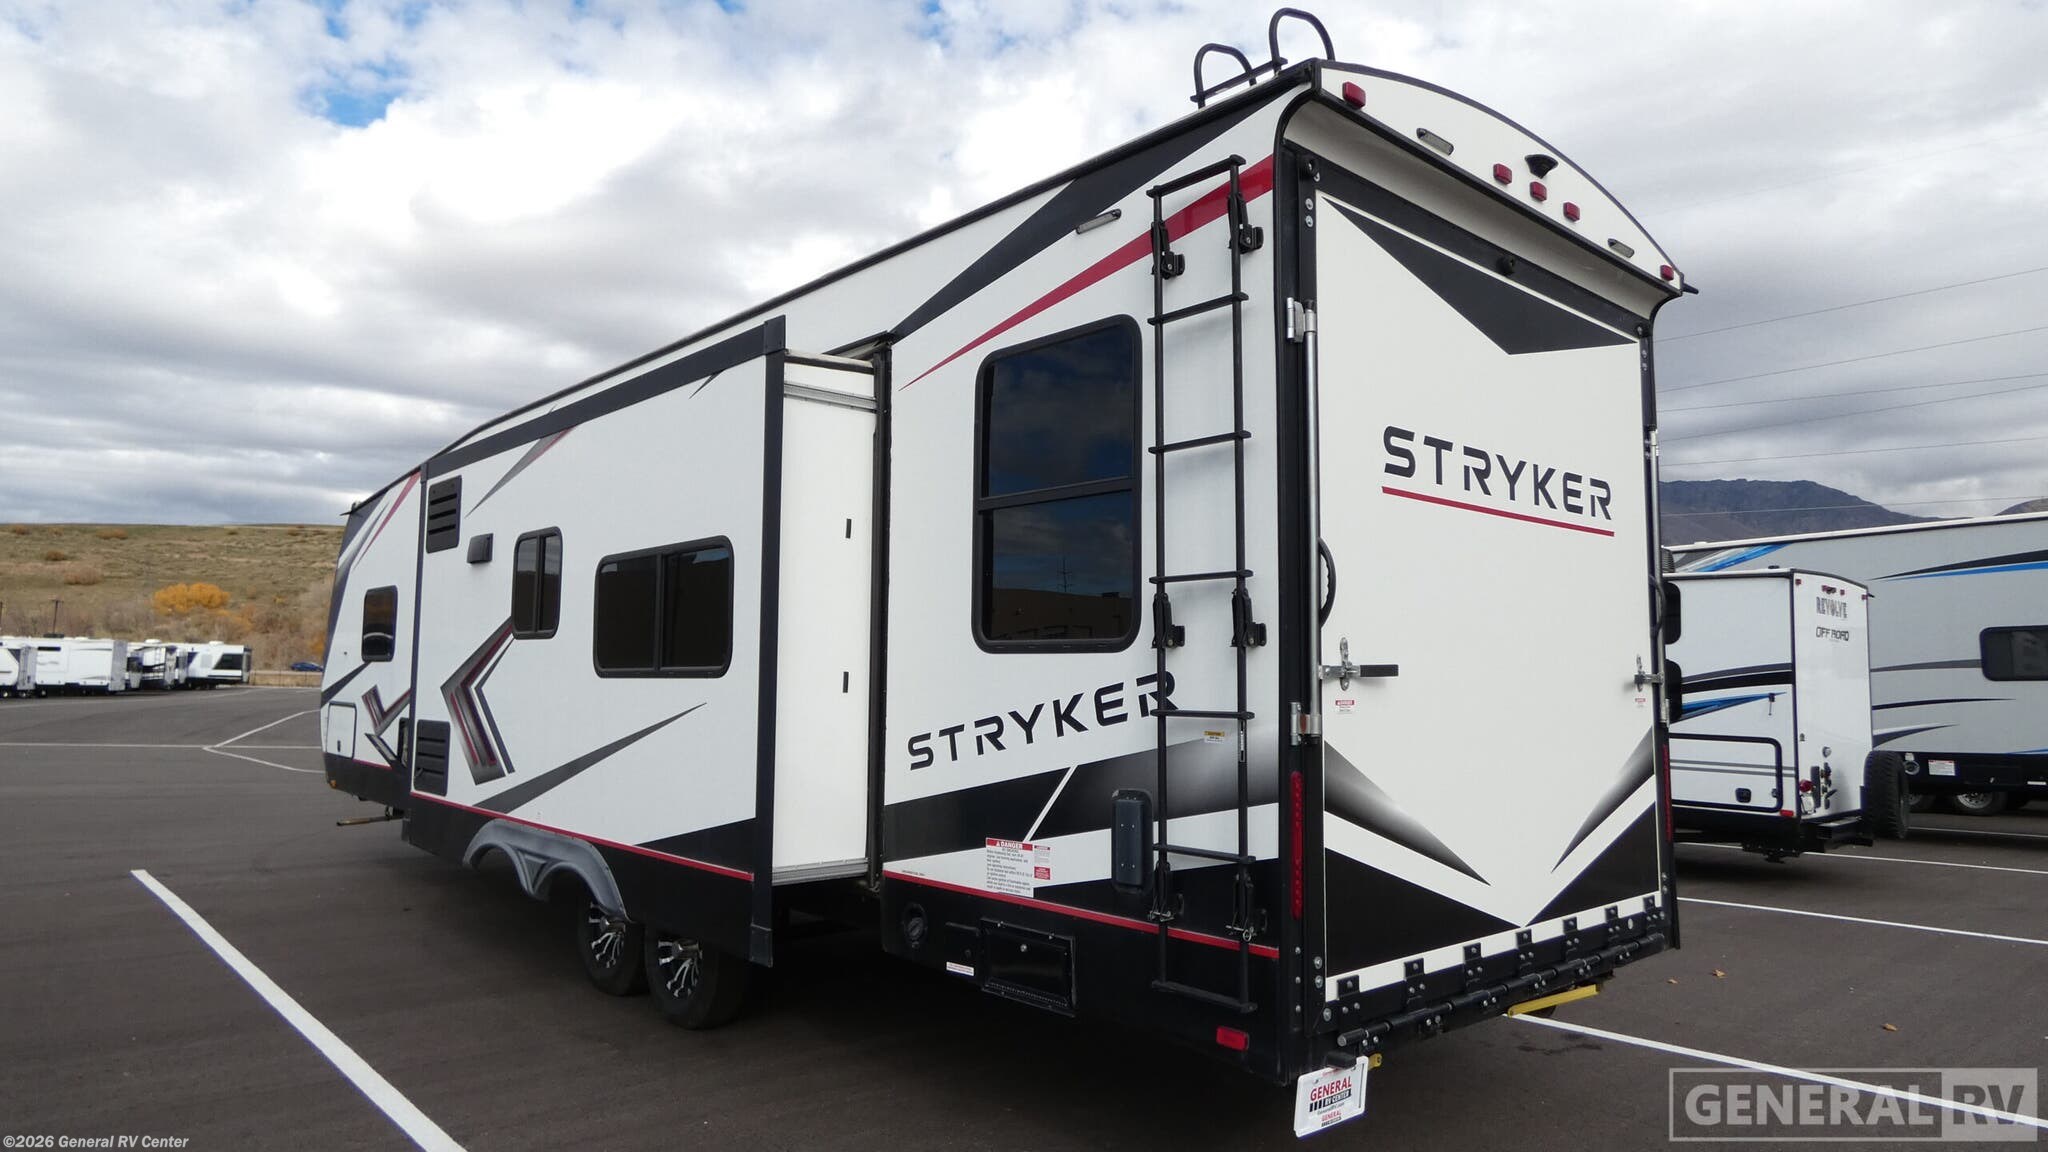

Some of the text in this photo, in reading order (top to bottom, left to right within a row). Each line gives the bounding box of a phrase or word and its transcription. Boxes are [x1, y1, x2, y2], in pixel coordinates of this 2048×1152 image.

[1383, 425, 1612, 521] STRYKER
[1816, 596, 1848, 619] REVOLVE
[1816, 626, 1850, 642] OFF ROAD
[907, 670, 1179, 771] STRYKER
[1000, 841, 1023, 851] DANGER
[1310, 1076, 1352, 1102] GENERAL
[1321, 1110, 1342, 1122] GENERAL
